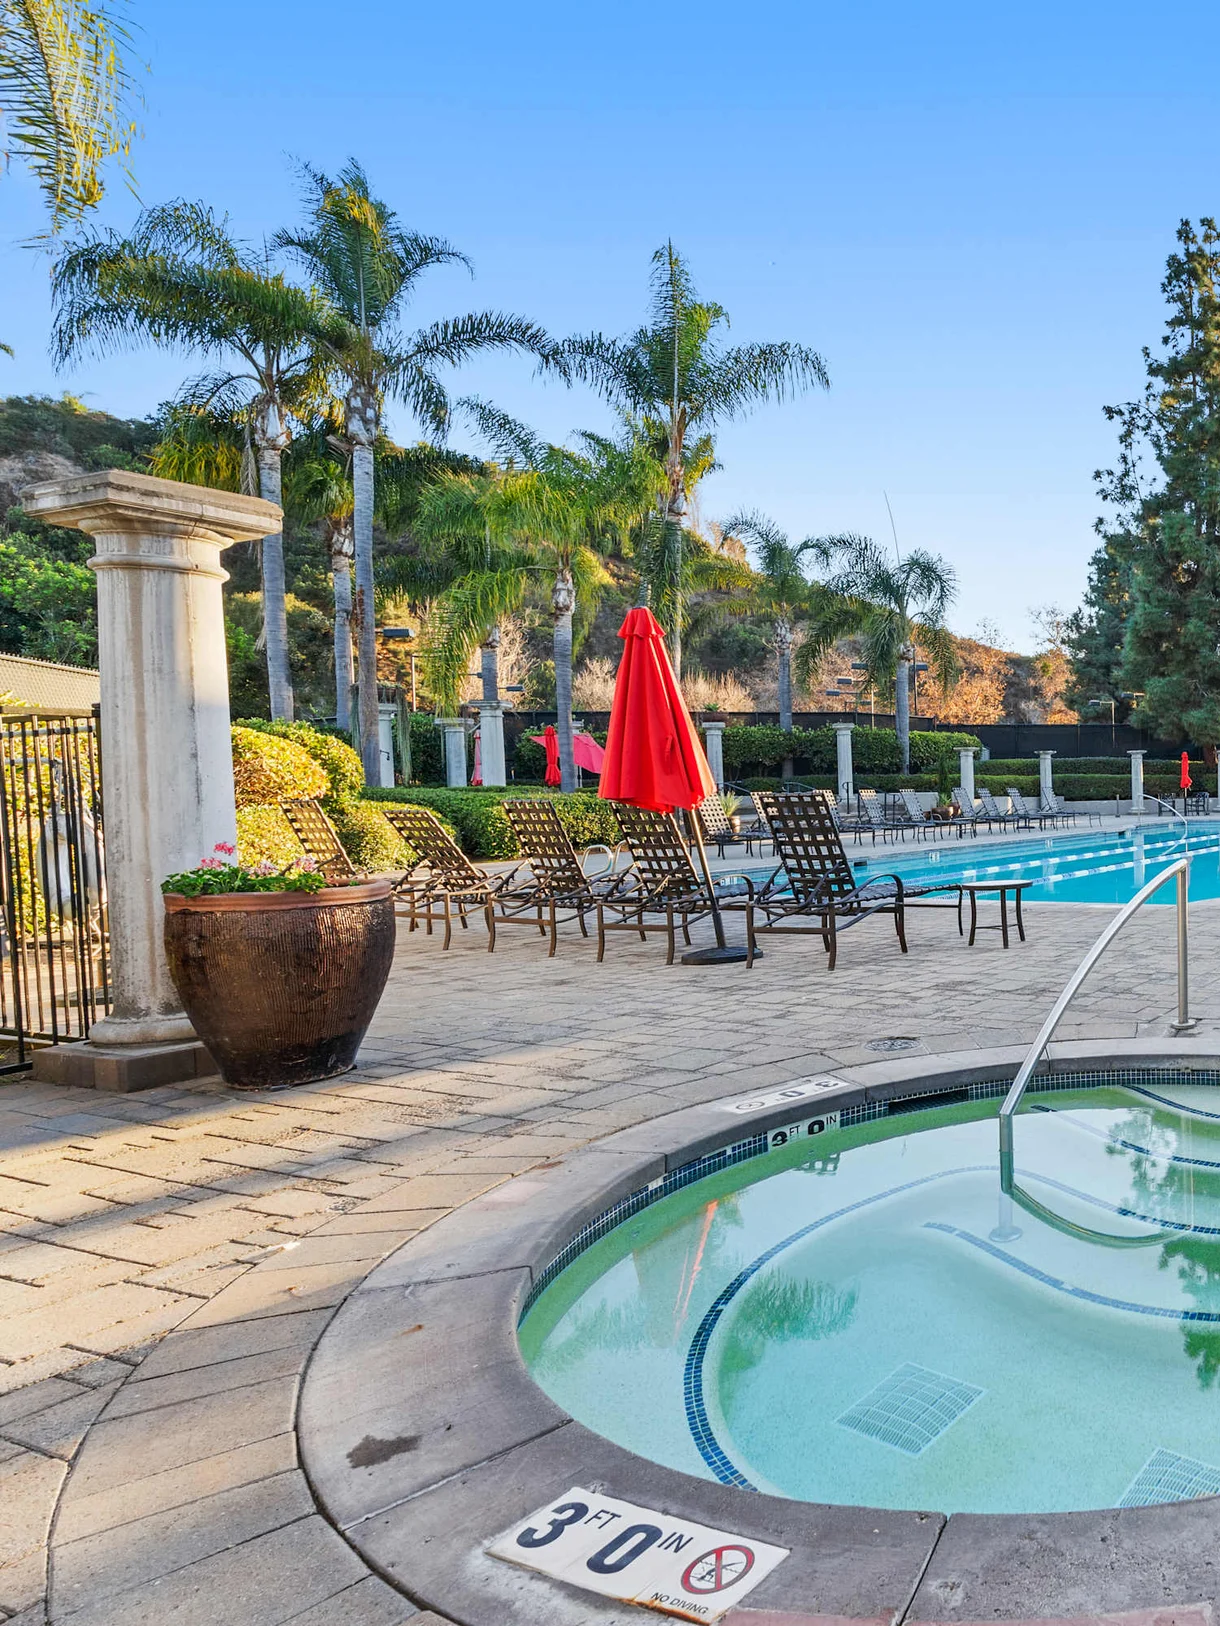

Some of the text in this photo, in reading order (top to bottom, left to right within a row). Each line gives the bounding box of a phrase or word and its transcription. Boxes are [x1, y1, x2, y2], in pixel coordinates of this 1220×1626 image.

[771, 1115, 836, 1147] 3 FT 0 IN
[516, 1502, 694, 1574] 3 FT 0 IN
[651, 1592, 709, 1615] NO DIVING
